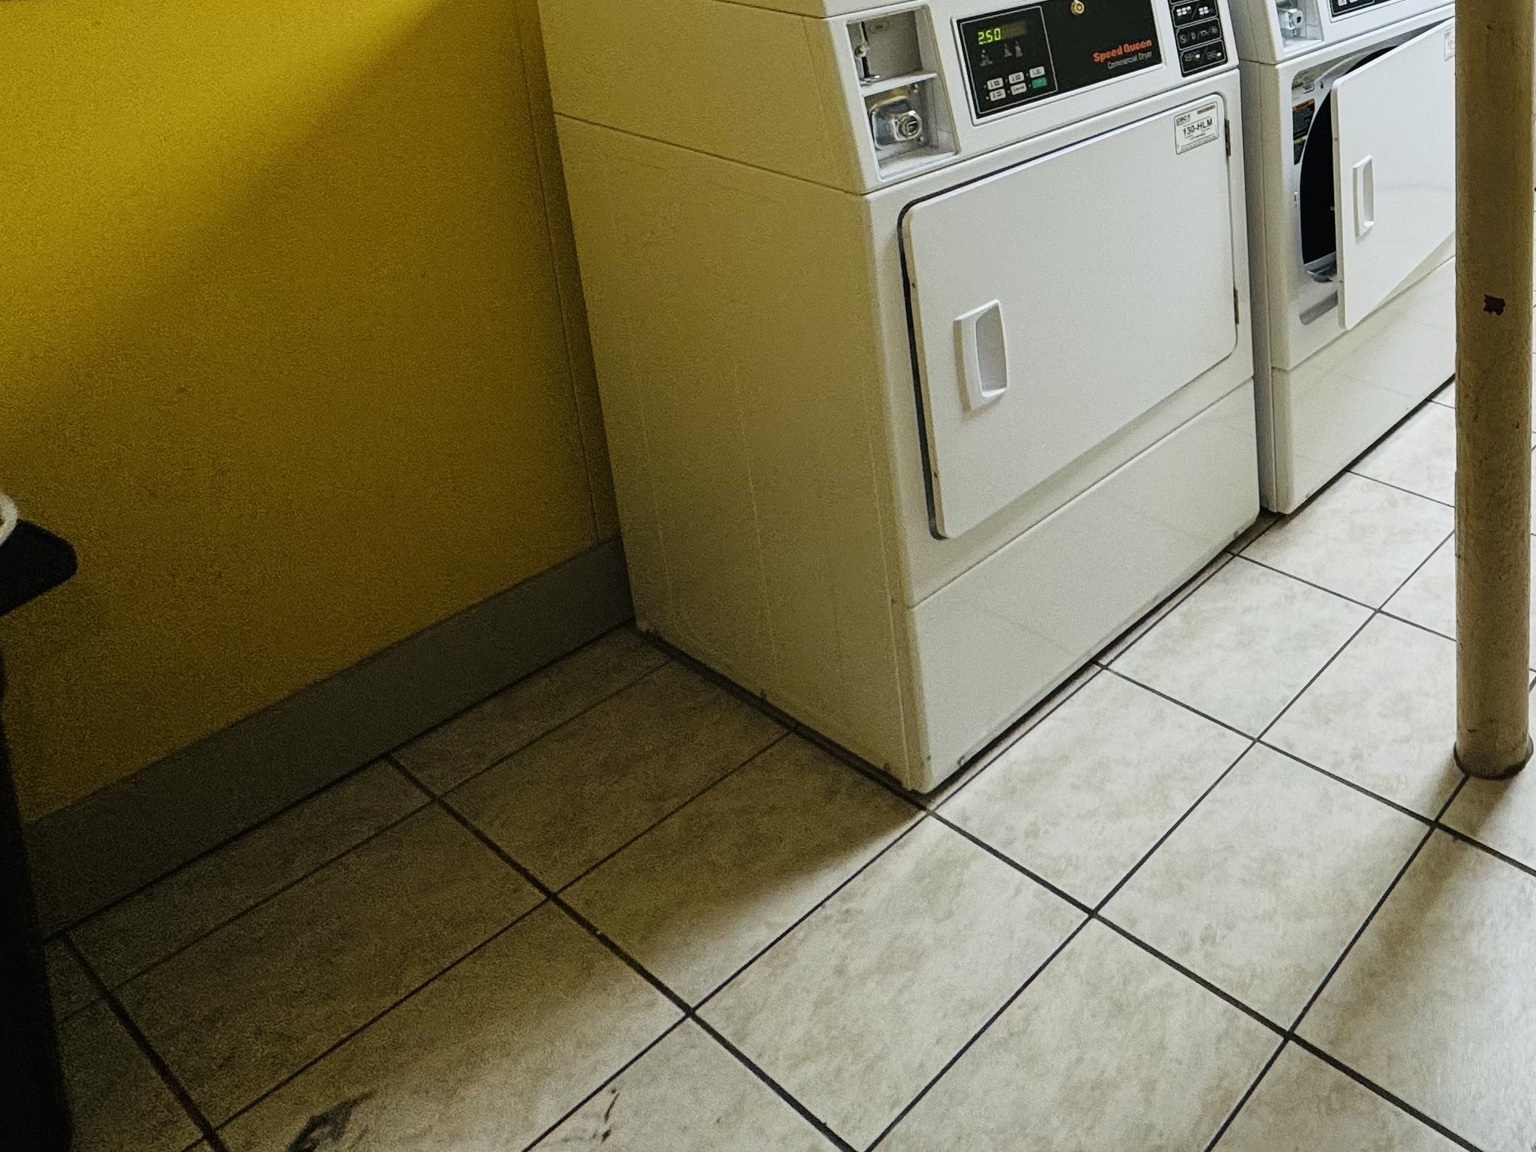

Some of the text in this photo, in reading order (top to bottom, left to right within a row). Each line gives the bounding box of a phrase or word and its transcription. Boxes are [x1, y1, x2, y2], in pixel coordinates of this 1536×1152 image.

[1092, 38, 1153, 63] Speed Queen
[1183, 117, 1213, 137] 130-HLM
